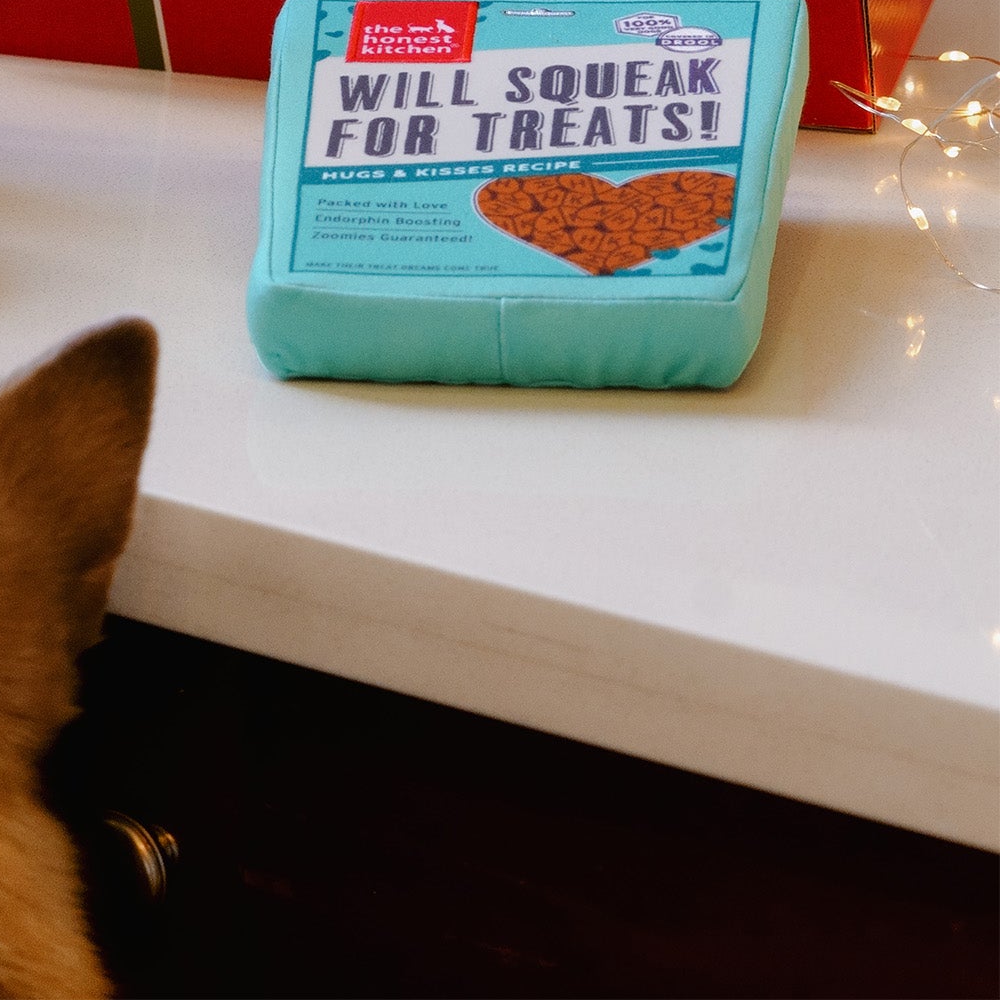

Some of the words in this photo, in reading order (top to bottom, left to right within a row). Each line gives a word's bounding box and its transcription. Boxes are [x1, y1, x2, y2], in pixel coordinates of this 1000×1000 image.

[363, 24, 403, 34] the
[623, 19, 671, 27] 100%
[363, 34, 453, 44] honest
[339, 68, 479, 112] WILL
[505, 57, 722, 104] SQUEAK
[325, 115, 439, 158] FOR
[472, 101, 721, 154] TREATS!
[321, 169, 385, 180] HUGS
[393, 169, 407, 178] &
[416, 165, 494, 178] KISSES
[503, 160, 581, 173] RECIPE
[317, 199, 371, 208] Packed
[376, 199, 408, 209] with
[414, 201, 448, 210] Love
[315, 214, 390, 225] Endorphin
[395, 217, 461, 228] Boosting
[311, 231, 375, 241] Zoomies
[380, 233, 473, 243] Guaranteed!
